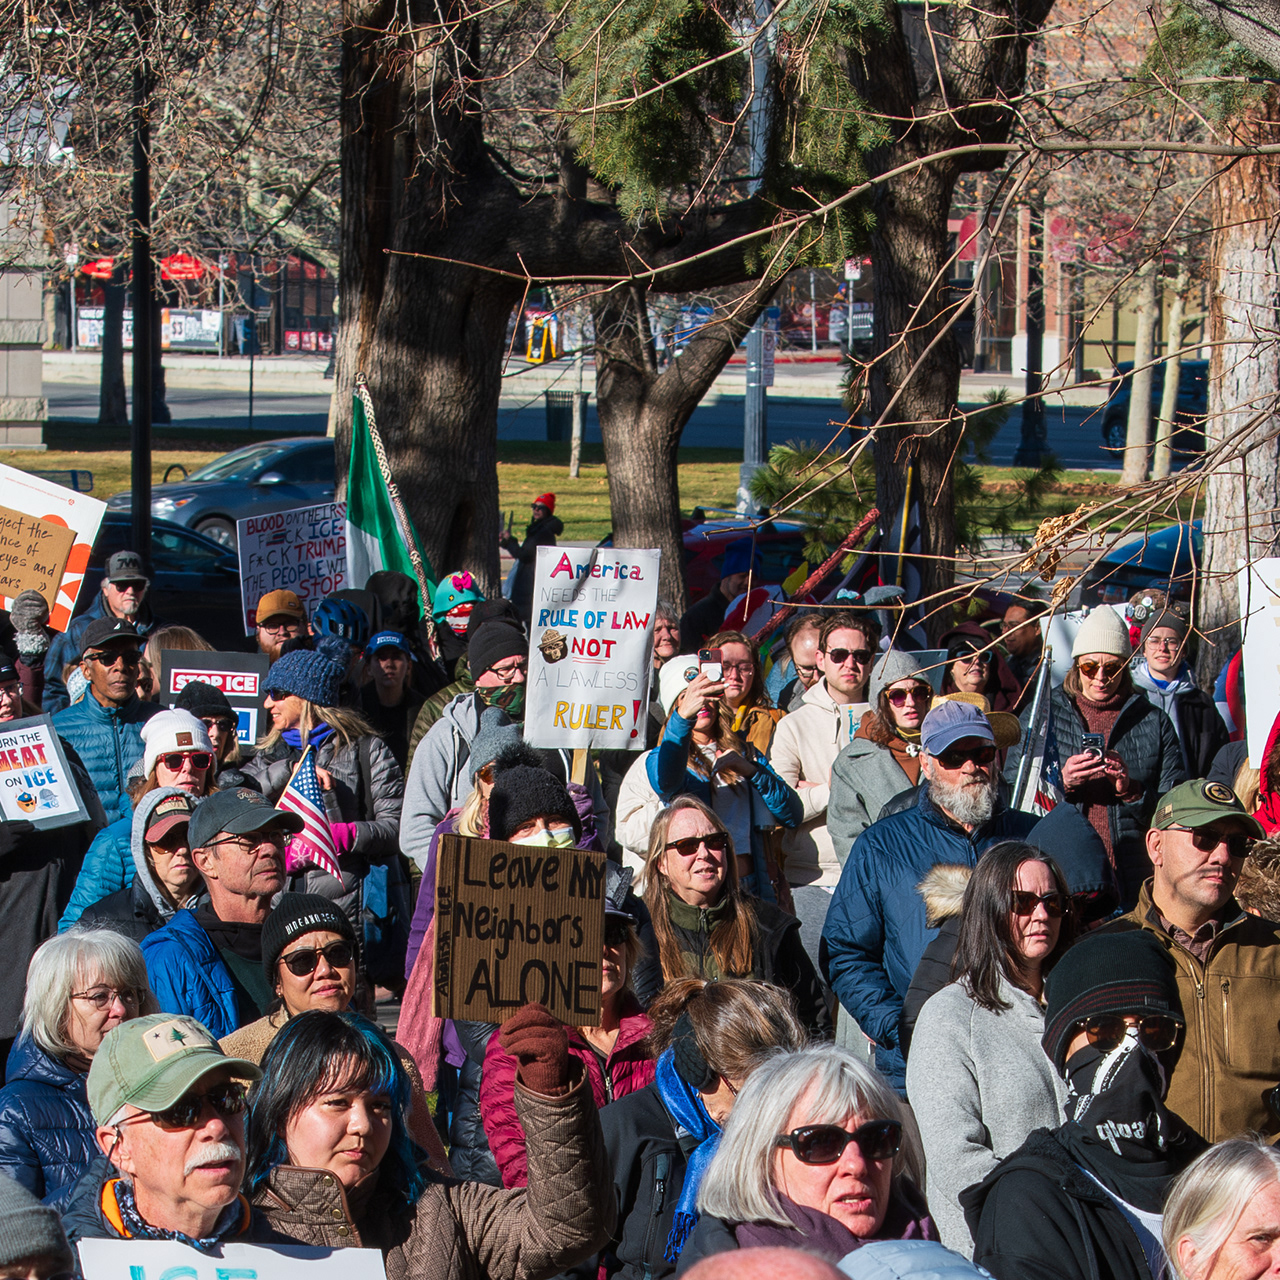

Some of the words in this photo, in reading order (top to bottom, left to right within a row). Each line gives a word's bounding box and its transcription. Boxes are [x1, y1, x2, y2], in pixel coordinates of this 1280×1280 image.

[28, 523, 53, 539] the
[246, 514, 285, 536] BLOOD
[26, 542, 40, 556] of
[258, 527, 304, 549] FCK
[294, 536, 346, 562] TRUMP
[33, 563, 57, 577] and
[243, 572, 267, 592] THE
[271, 560, 325, 587] PEOPLE
[550, 552, 644, 581] America
[297, 573, 344, 599] STOP
[540, 586, 586, 603] NEEDS
[592, 587, 619, 602] THE
[538, 608, 577, 627] RULE
[584, 610, 607, 629] OF
[611, 611, 650, 630] LAW
[571, 636, 617, 658] NOT
[225, 676, 255, 692] ICE
[535, 666, 548, 687] A
[556, 669, 638, 691] LAWLESS
[19, 732, 42, 744] THE
[5, 776, 22, 787] ON
[22, 766, 58, 788] ICE
[464, 839, 560, 892] Leave
[437, 885, 451, 915] ICE
[455, 902, 583, 960] Neighbors
[464, 958, 598, 1015] ALONE
